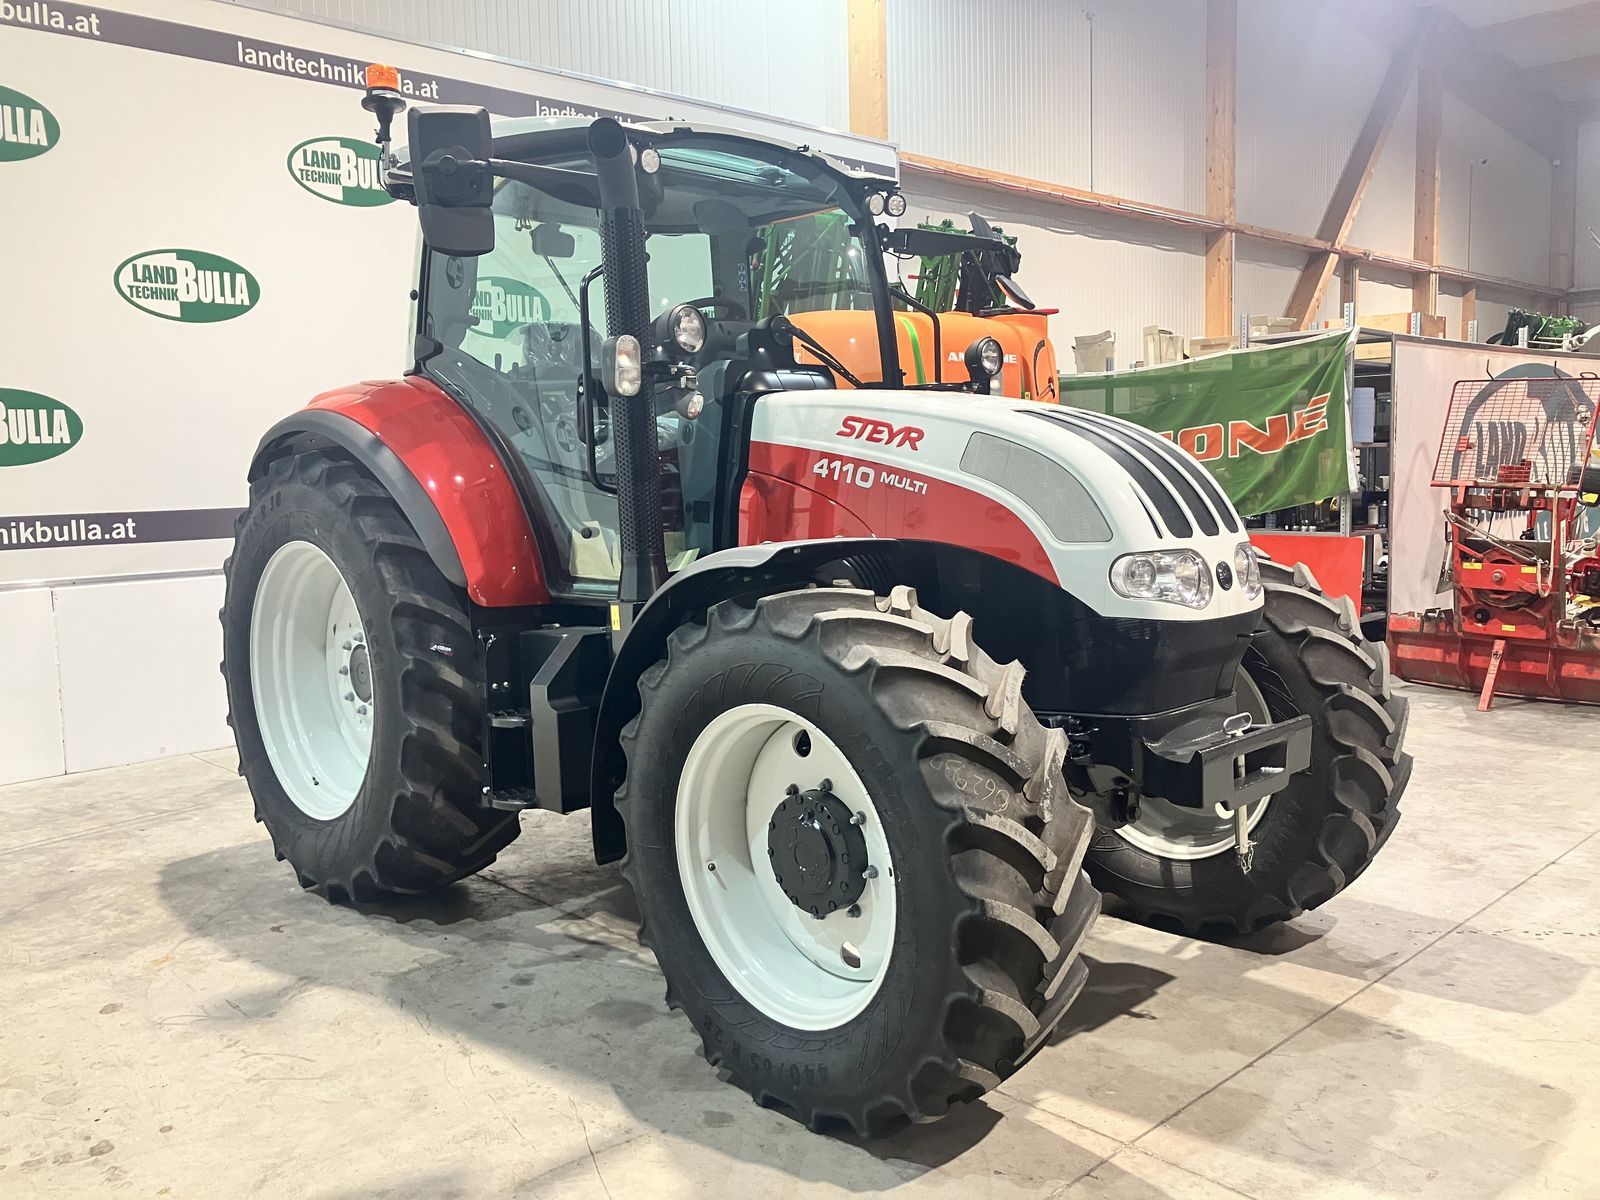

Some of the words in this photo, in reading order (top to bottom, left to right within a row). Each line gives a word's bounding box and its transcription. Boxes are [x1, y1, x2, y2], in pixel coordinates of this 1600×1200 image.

[302, 148, 340, 170] LAND
[298, 168, 342, 185] TECHNIK
[131, 263, 178, 285] LAND
[176, 259, 250, 306] BULLA
[127, 285, 180, 302] TECHNIK
[491, 286, 543, 323] BULLA
[835, 415, 925, 452] STEYR
[812, 458, 875, 489] 4110
[880, 471, 928, 495] MULTI
